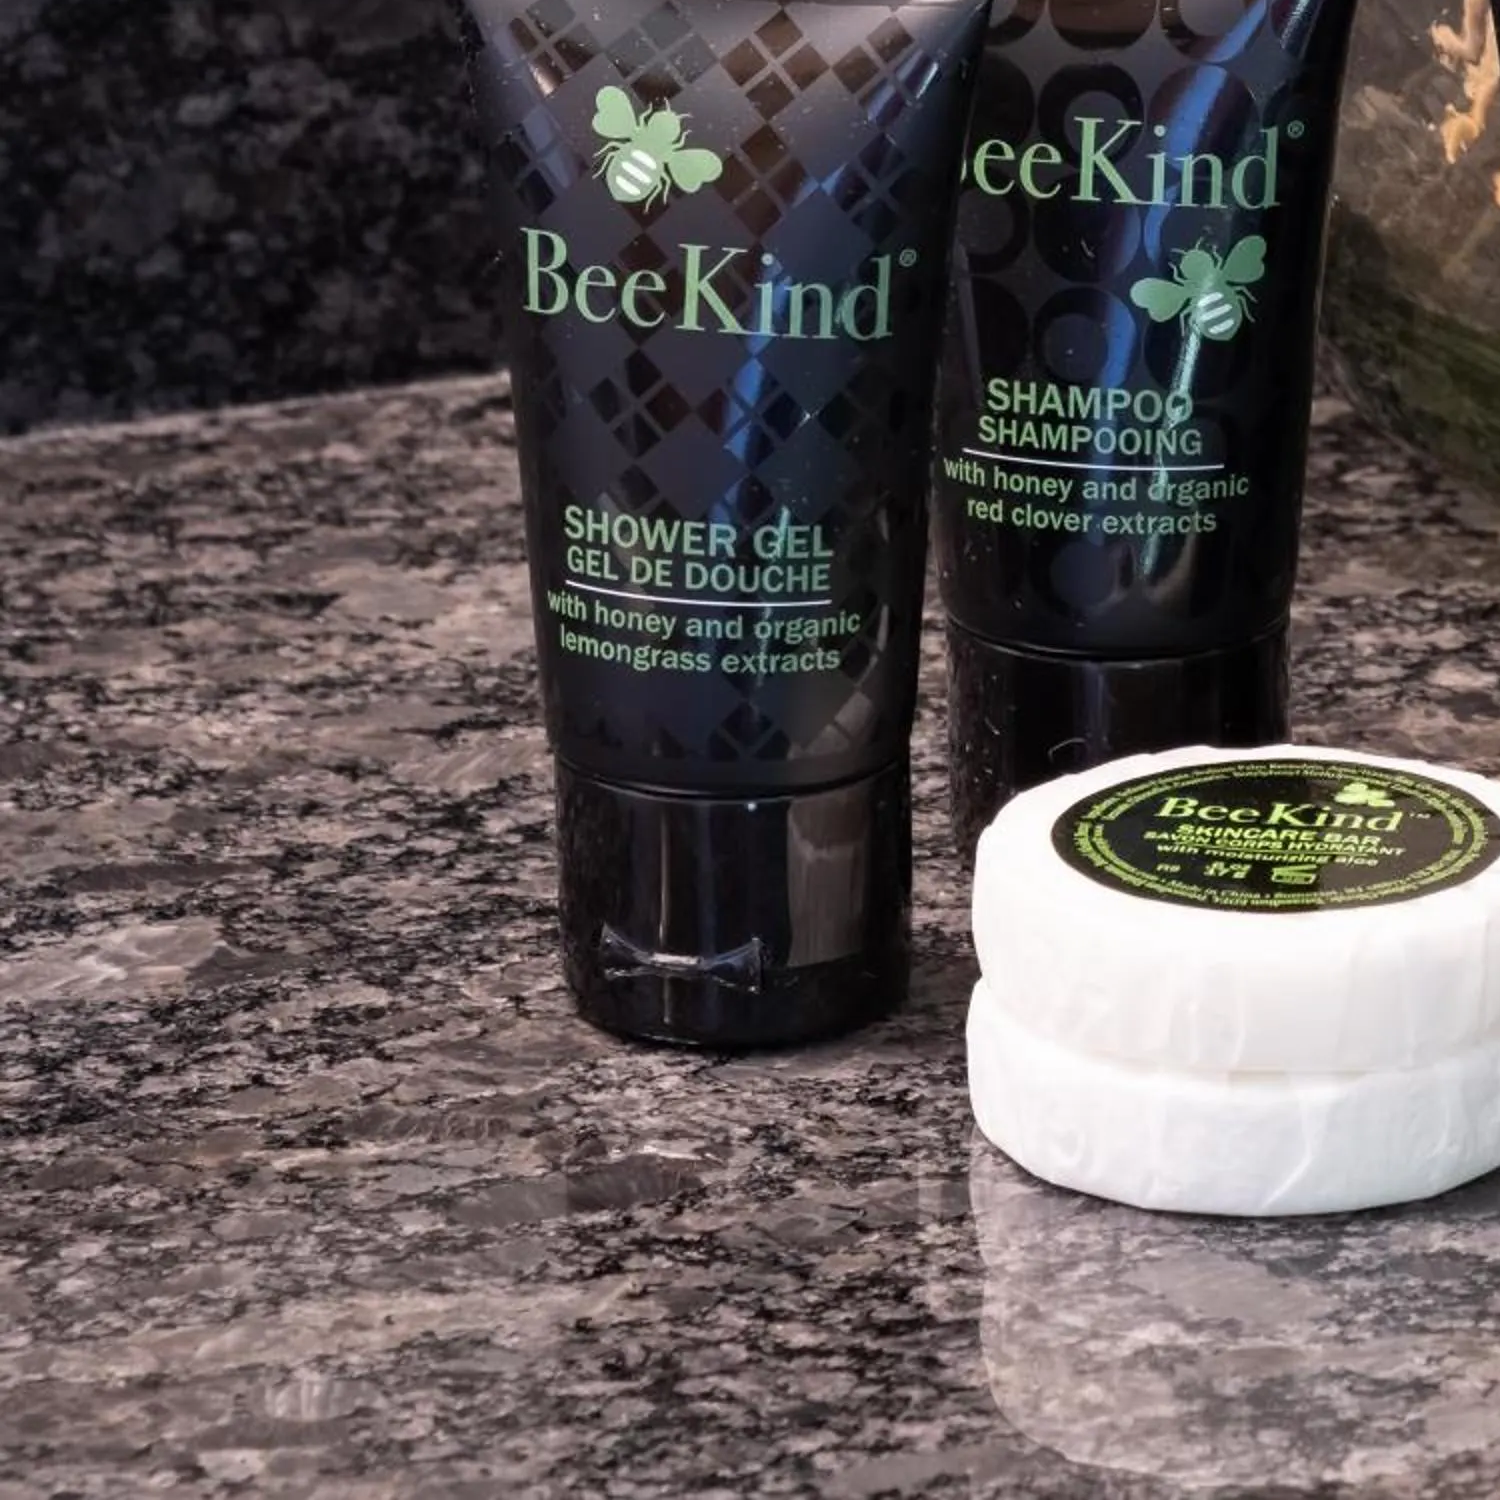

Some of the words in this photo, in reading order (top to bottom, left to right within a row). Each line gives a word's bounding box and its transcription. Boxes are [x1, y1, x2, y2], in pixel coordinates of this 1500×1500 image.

[987, 377, 1192, 424] SHAMPOO
[979, 415, 1203, 456] SHAMPOOING
[944, 456, 985, 487] with
[994, 466, 1073, 499] honey
[1083, 477, 1137, 501] and
[1148, 474, 1249, 507] organic
[565, 505, 737, 557] SHOWER
[754, 524, 833, 558] GEL
[967, 496, 1002, 523] red
[1012, 504, 1092, 533] clover
[1102, 510, 1217, 536] extracts
[567, 545, 619, 581] GEL
[630, 556, 673, 588] DE
[686, 559, 831, 592] DOUCHE
[548, 589, 588, 623] with
[595, 601, 677, 639] honey
[685, 612, 743, 640] and
[754, 611, 861, 644] organic
[560, 623, 711, 672] lemongrass
[721, 648, 840, 674] extracts
[1144, 831, 1211, 843] SAVON
[1216, 839, 1283, 850] CORPS
[1288, 842, 1406, 856] HYDRATANT
[1157, 845, 1199, 854] with
[1334, 856, 1379, 867] aloe
[1176, 823, 1317, 842] SKINCARE
[1324, 832, 1381, 845] BAR
